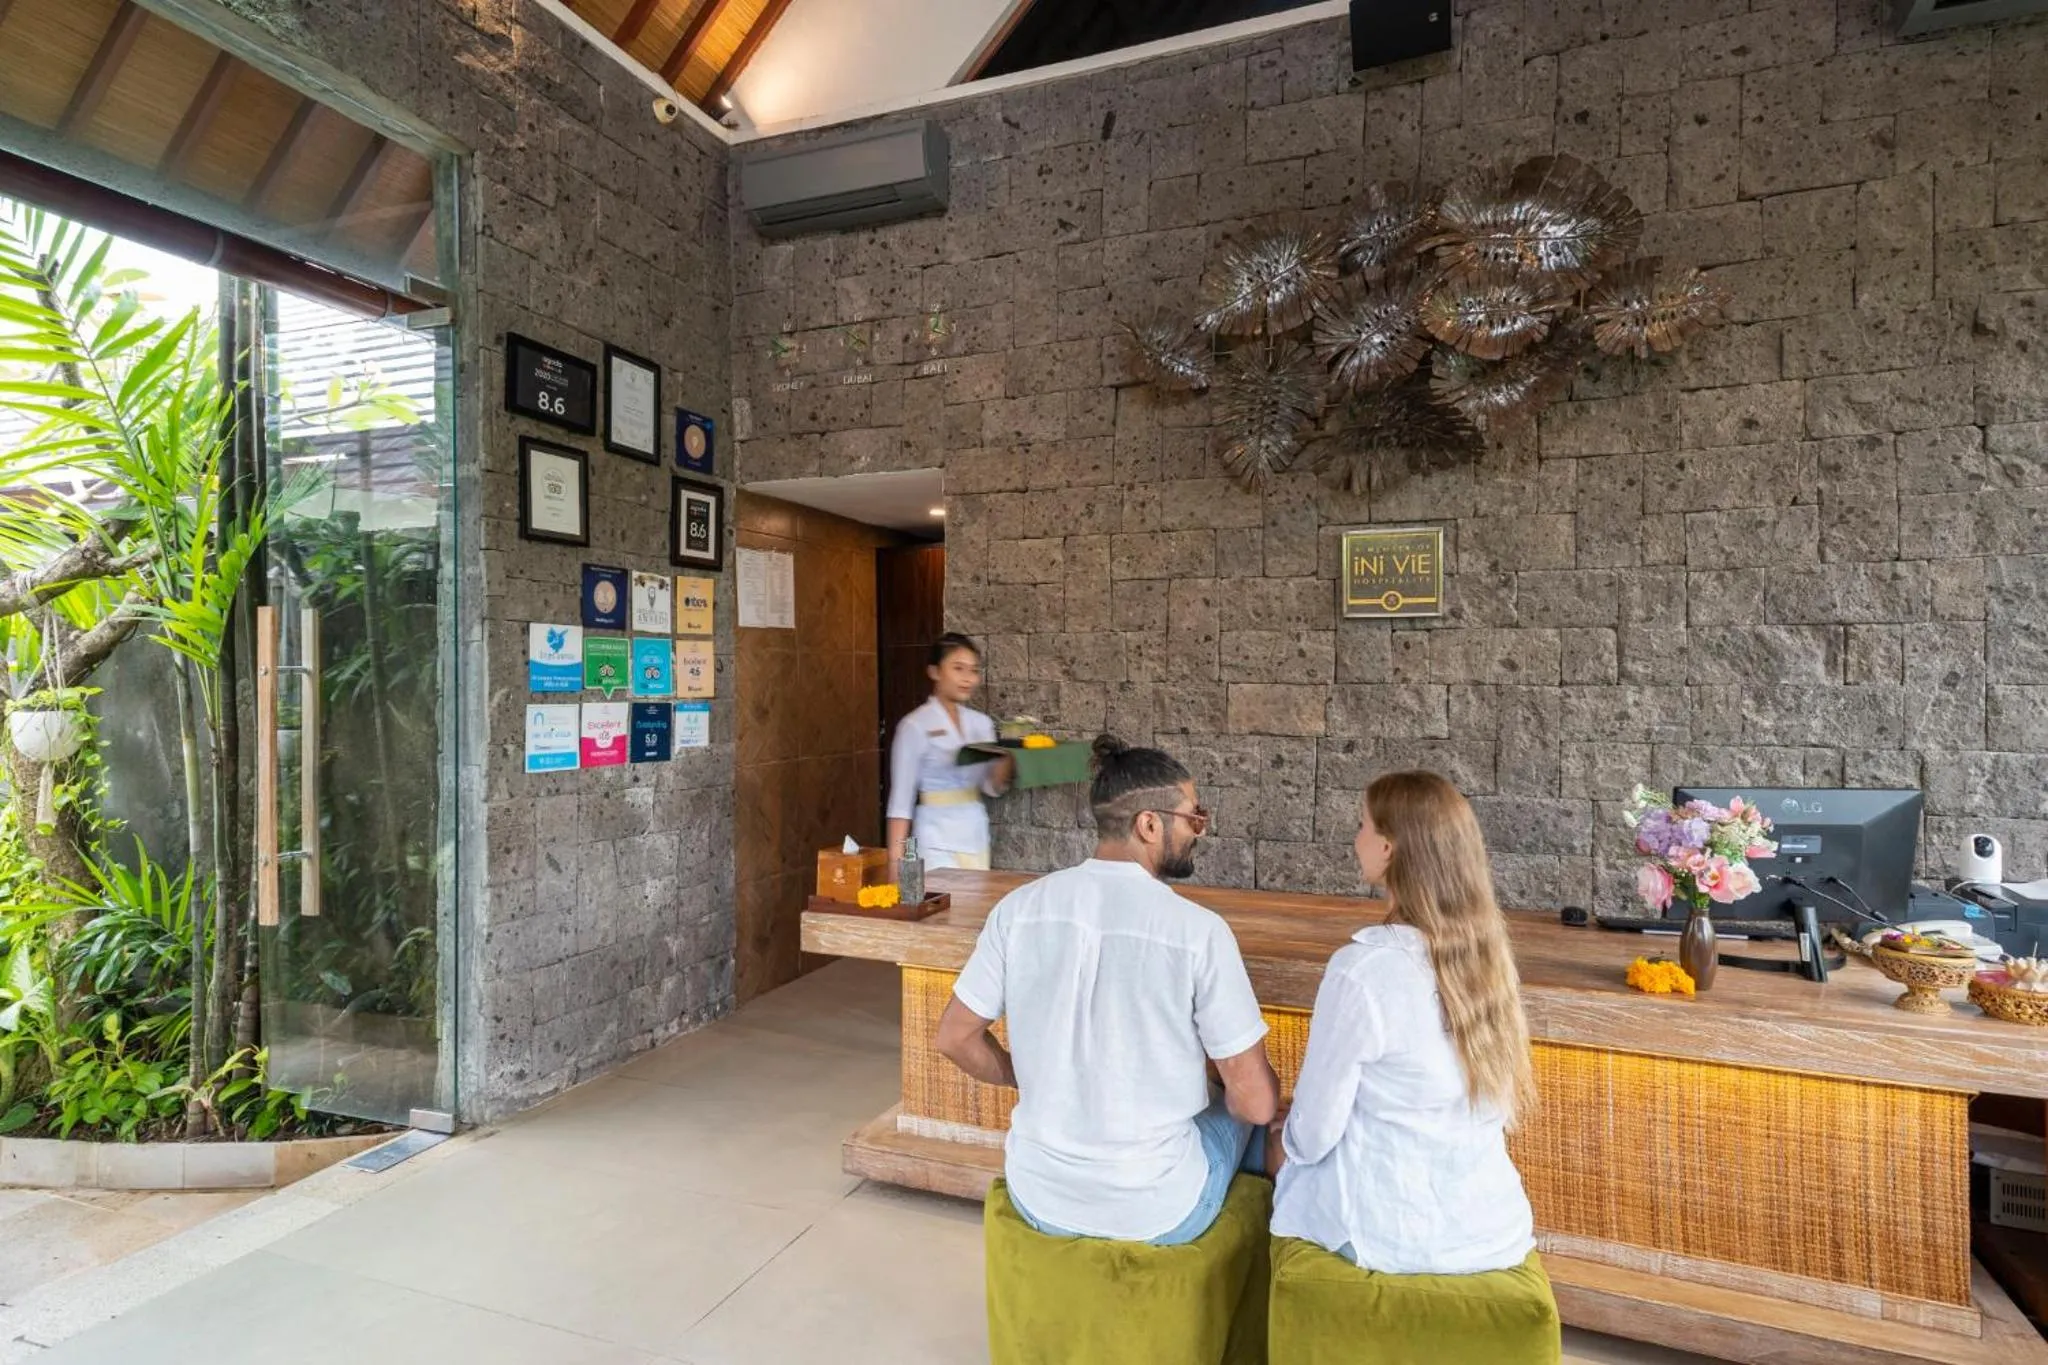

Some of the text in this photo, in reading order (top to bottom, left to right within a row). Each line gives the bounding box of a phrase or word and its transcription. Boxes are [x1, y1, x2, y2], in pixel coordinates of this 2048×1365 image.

[922, 363, 949, 375] BALI
[842, 373, 873, 385] DUBAI
[538, 391, 566, 415] 8.6
[1802, 801, 1823, 813] LG
